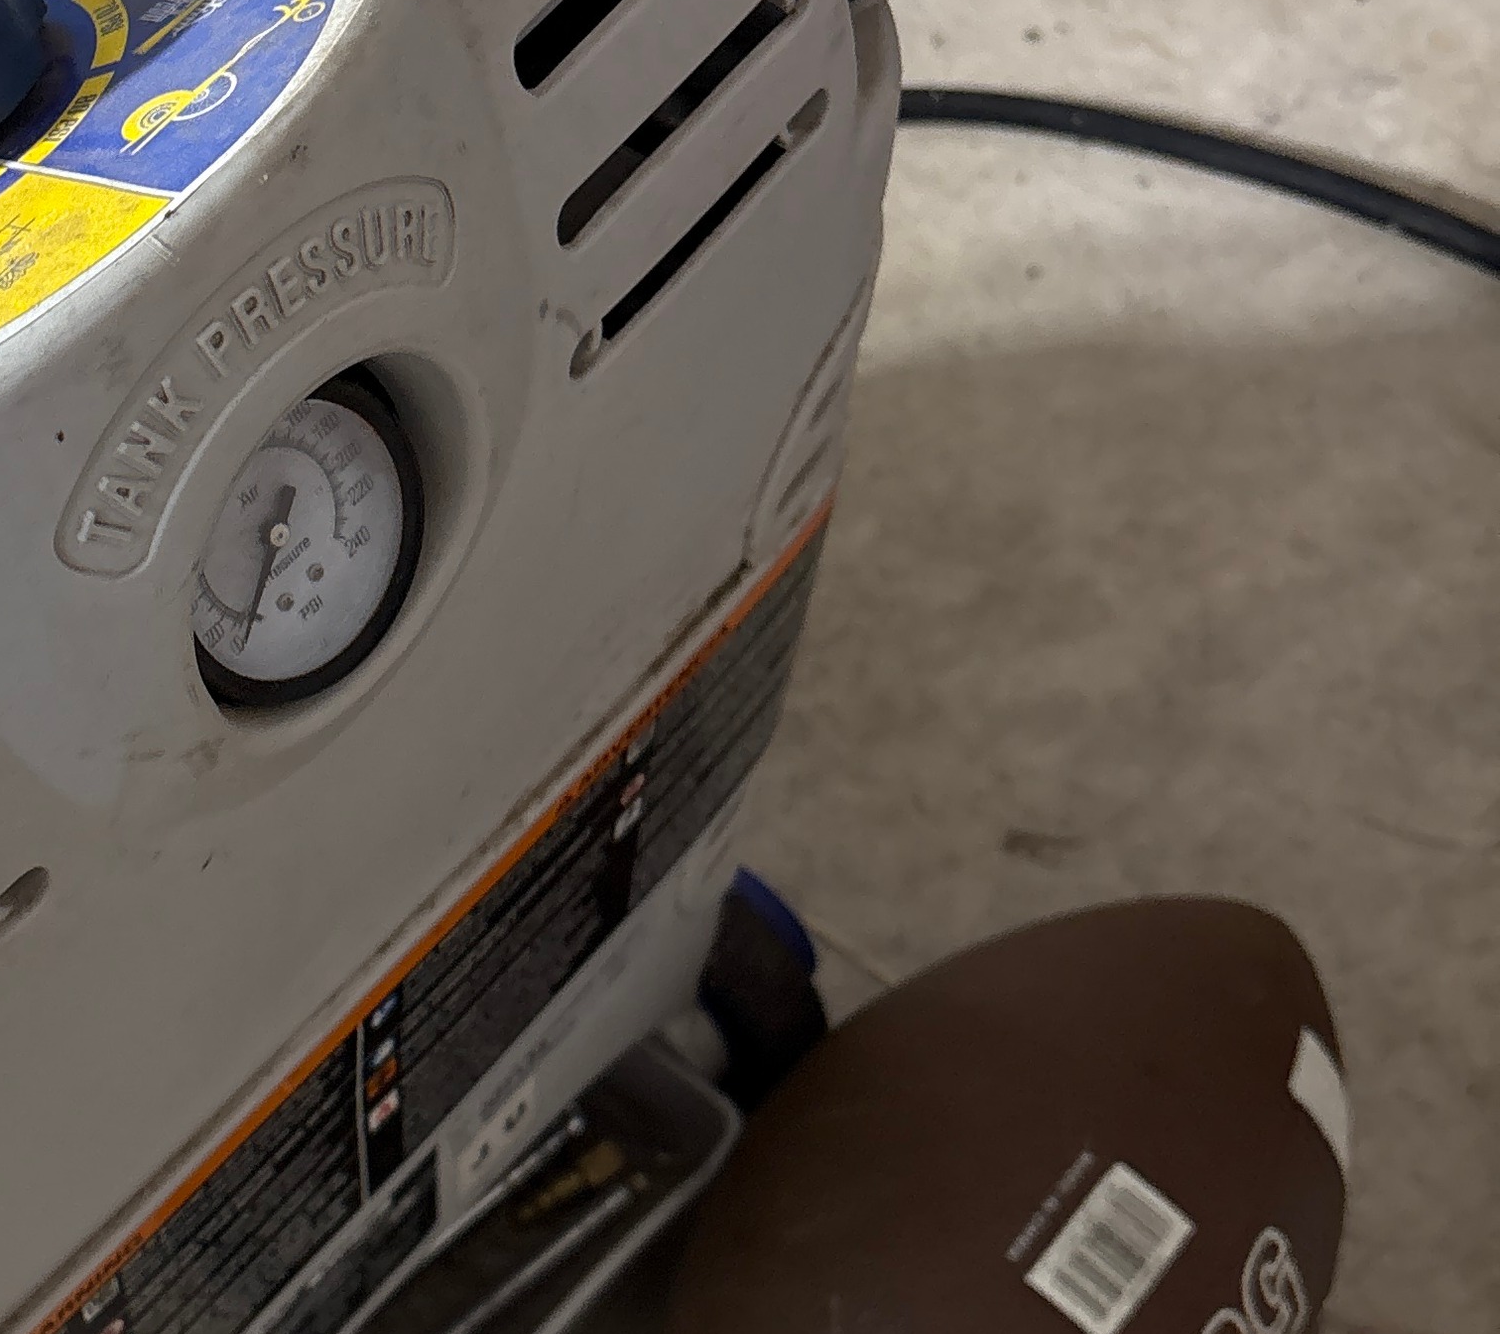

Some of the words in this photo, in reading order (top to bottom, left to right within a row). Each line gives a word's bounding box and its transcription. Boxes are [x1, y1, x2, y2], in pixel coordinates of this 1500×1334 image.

[76, 376, 202, 549] TANK
[196, 204, 438, 376] PRESSURE
[347, 474, 375, 507] 220
[345, 525, 372, 559] 240
